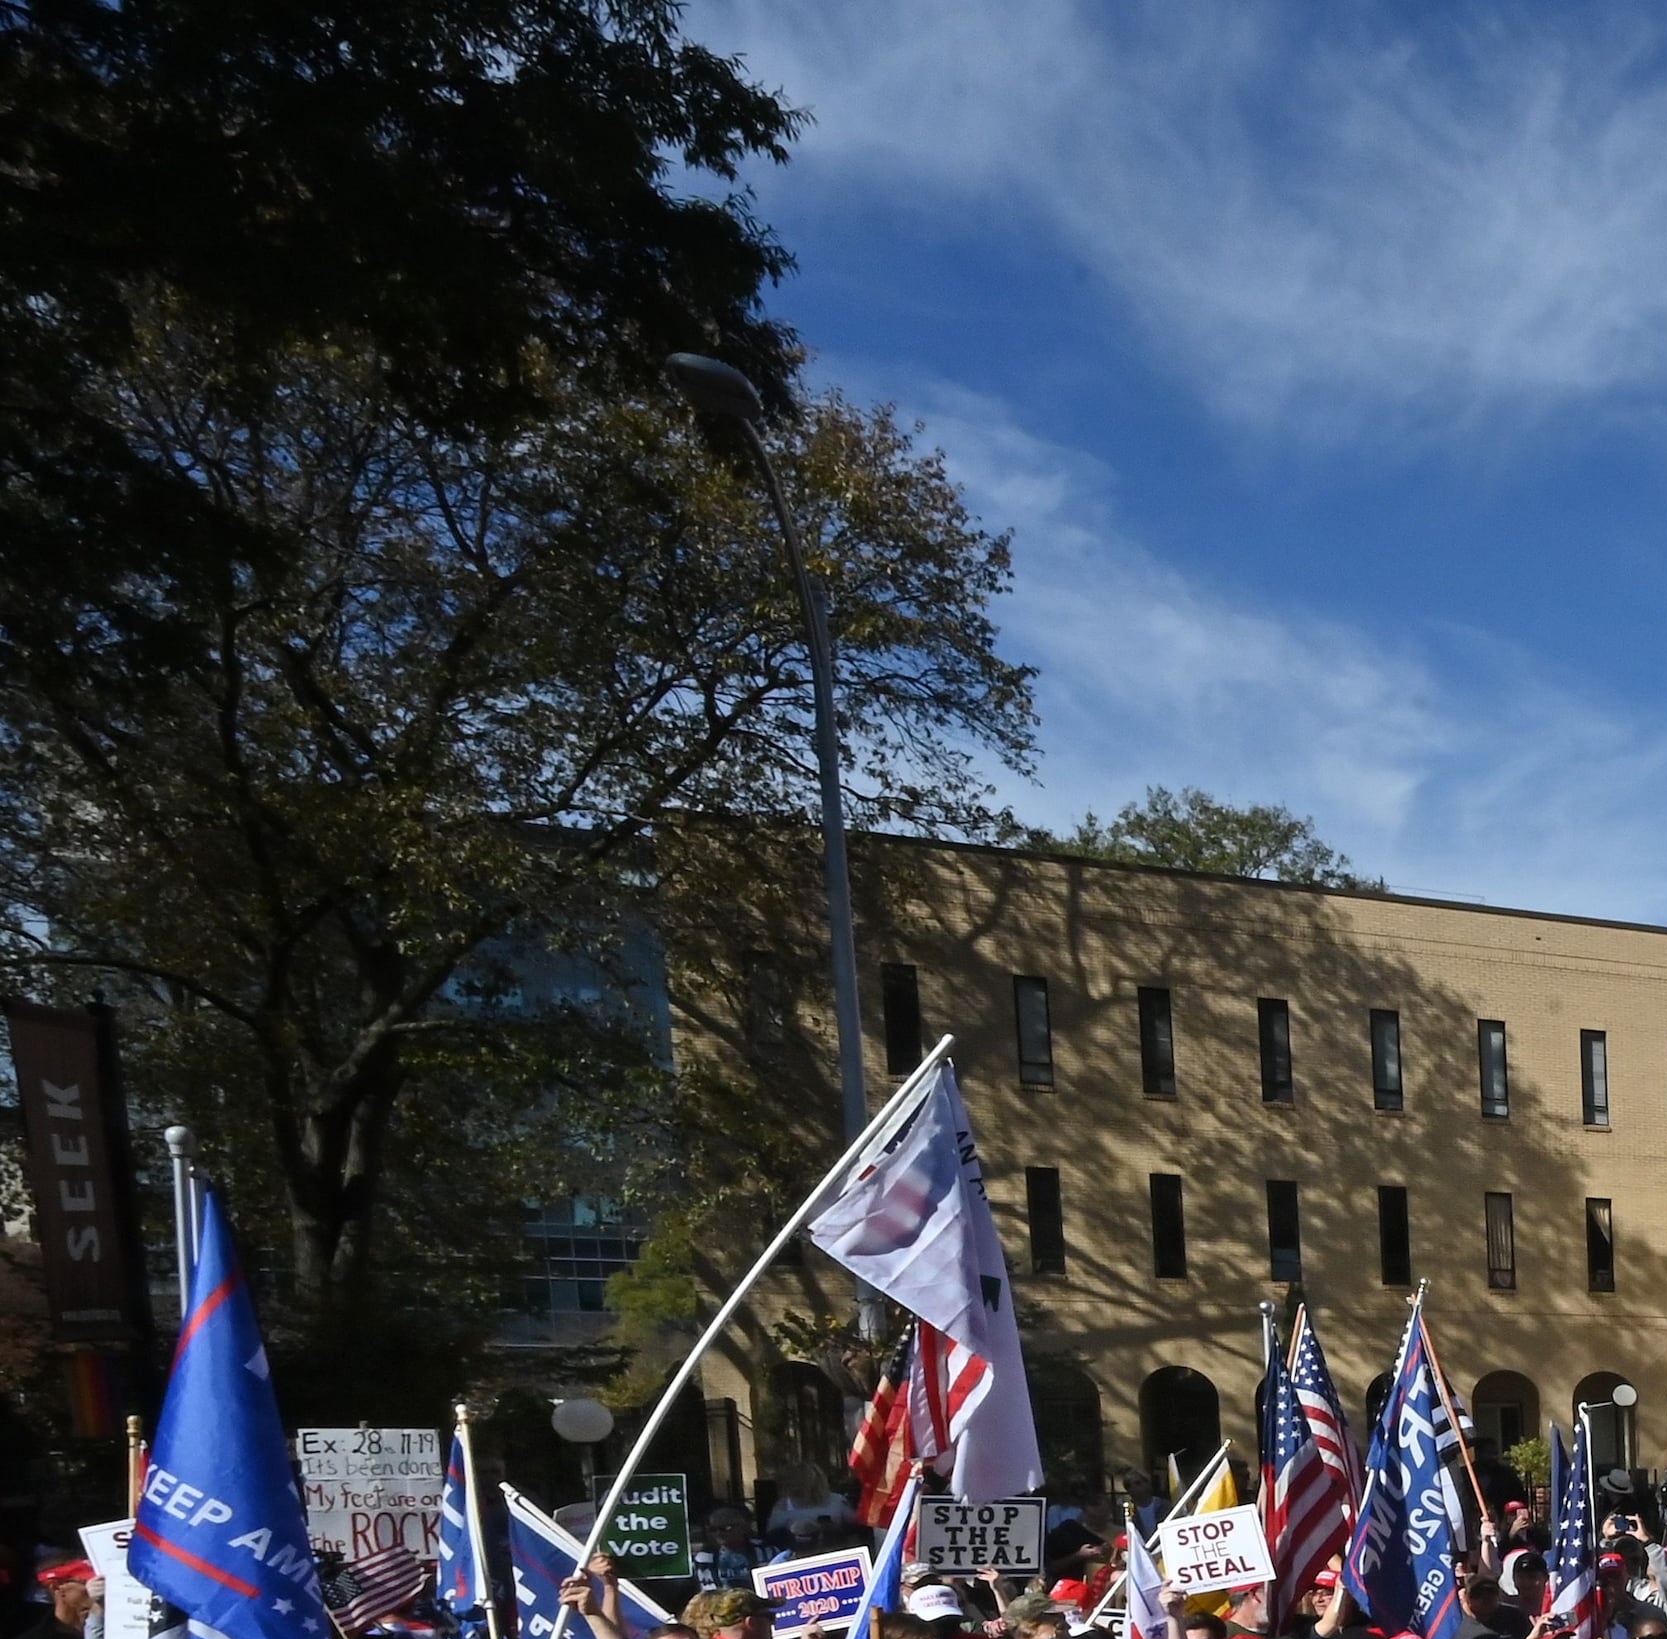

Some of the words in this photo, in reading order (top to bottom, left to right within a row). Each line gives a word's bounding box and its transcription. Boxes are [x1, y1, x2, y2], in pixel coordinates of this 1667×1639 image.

[41, 1079, 101, 1264] SEEK
[352, 1430, 383, 1456] 28
[305, 1457, 338, 1477] It's
[347, 1456, 394, 1477] been
[398, 1453, 443, 1478] done
[305, 1482, 337, 1509] My
[342, 1483, 385, 1509] feet
[388, 1490, 416, 1509] are
[621, 1487, 683, 1507] udit
[615, 1512, 668, 1533] the
[934, 1505, 1020, 1526] STOP
[352, 1512, 441, 1560] ROCK
[944, 1526, 1011, 1546] THE
[1177, 1519, 1235, 1546] STOP
[607, 1540, 679, 1560] Vote
[929, 1545, 1032, 1566] STEAL
[1189, 1540, 1229, 1562] THE
[1177, 1555, 1256, 1585] STEAL
[766, 1566, 863, 1601] TRUMP
[798, 1596, 840, 1619] 2020
